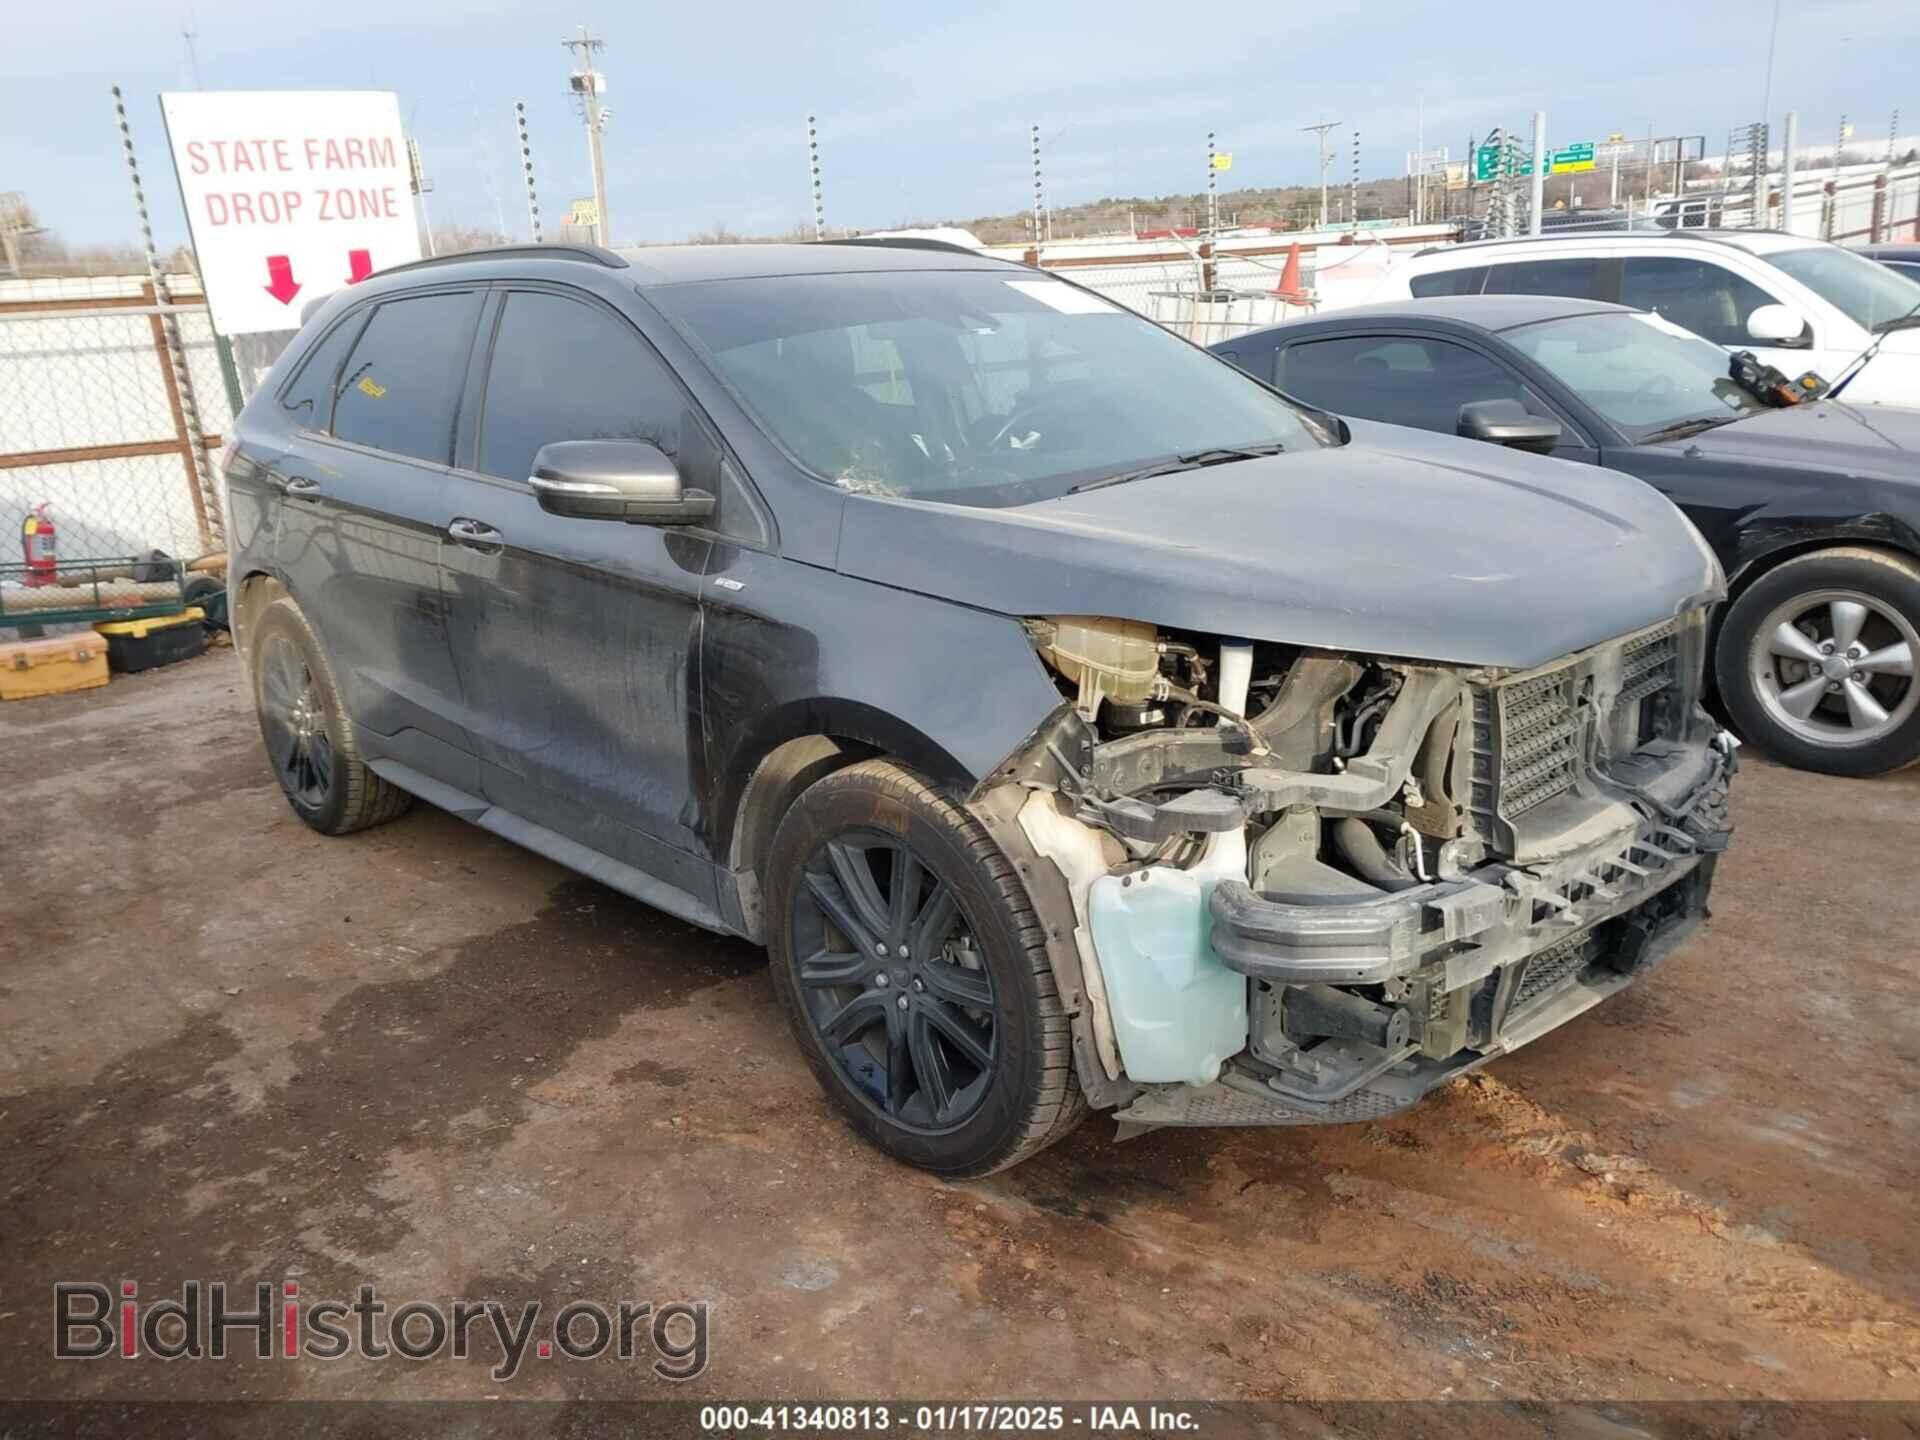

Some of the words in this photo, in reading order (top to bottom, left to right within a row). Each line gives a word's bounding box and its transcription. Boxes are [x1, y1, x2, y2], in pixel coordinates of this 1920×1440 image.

[186, 140, 293, 174] STATE
[303, 137, 397, 170] FARM
[205, 190, 302, 226] DROP
[315, 187, 400, 221] ZONE
